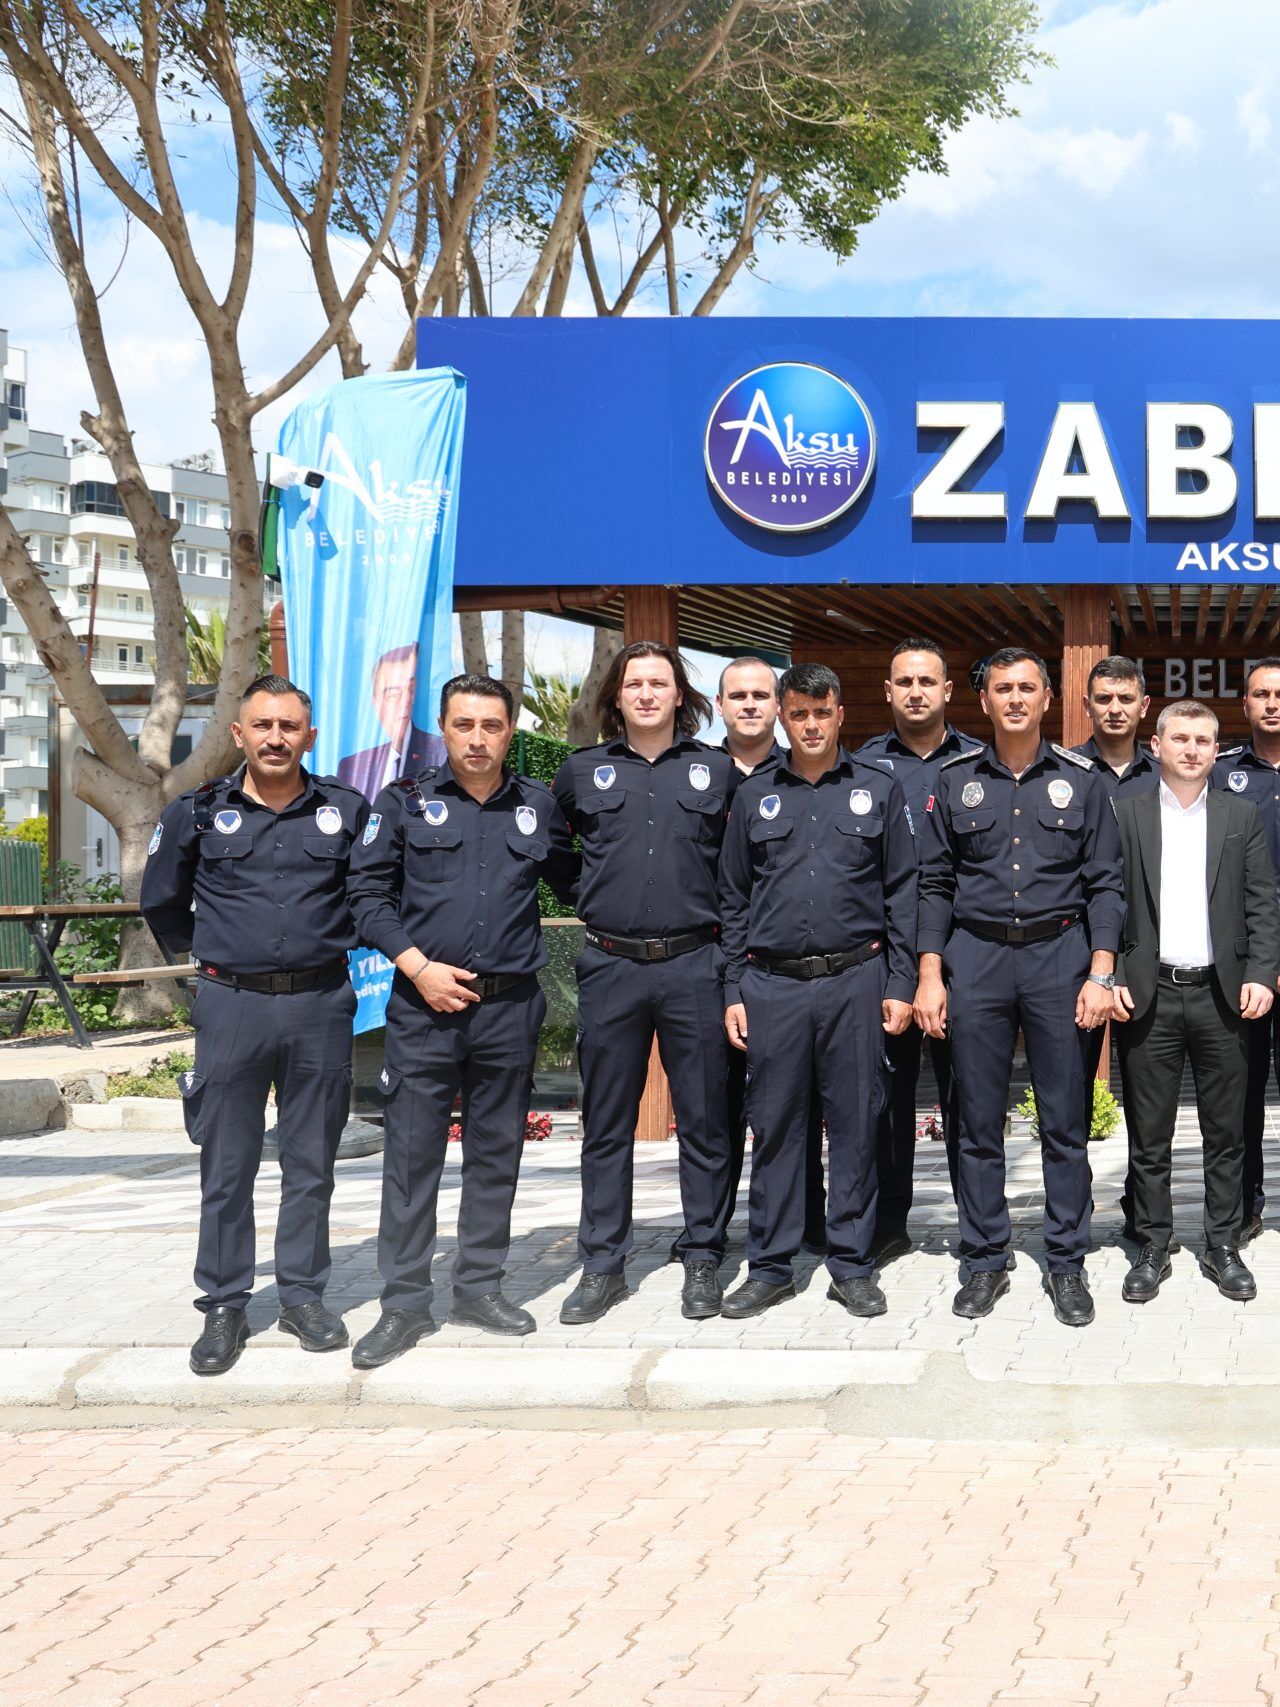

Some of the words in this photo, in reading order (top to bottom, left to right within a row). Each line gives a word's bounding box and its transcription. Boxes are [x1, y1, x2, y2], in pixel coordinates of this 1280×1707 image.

[719, 388, 860, 470] Aksu
[726, 470, 851, 486] BELEDİYESİ
[771, 494, 808, 503] 2009
